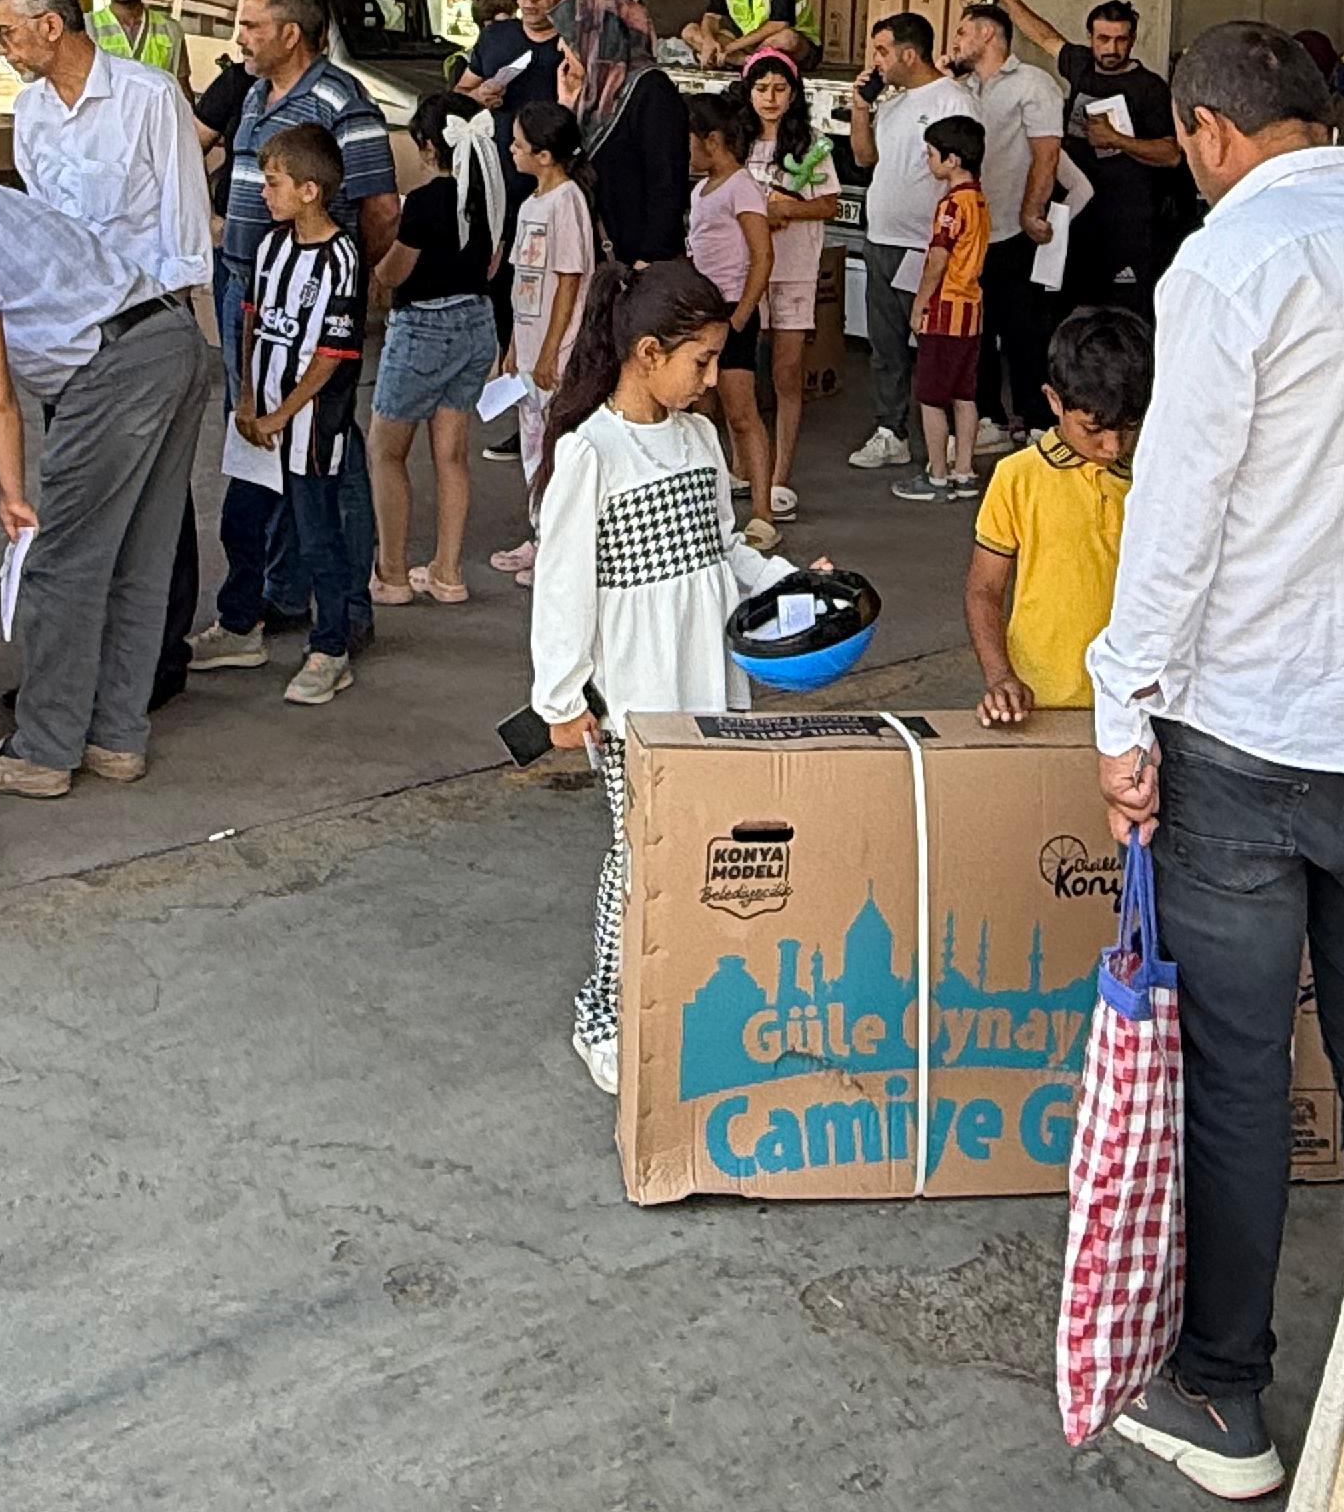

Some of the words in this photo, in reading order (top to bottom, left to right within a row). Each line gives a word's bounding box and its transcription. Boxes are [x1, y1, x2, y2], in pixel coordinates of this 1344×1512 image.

[712, 846, 784, 864] KONYA
[742, 1002, 887, 1063] Güle
[705, 1074, 1004, 1183] Camiye
